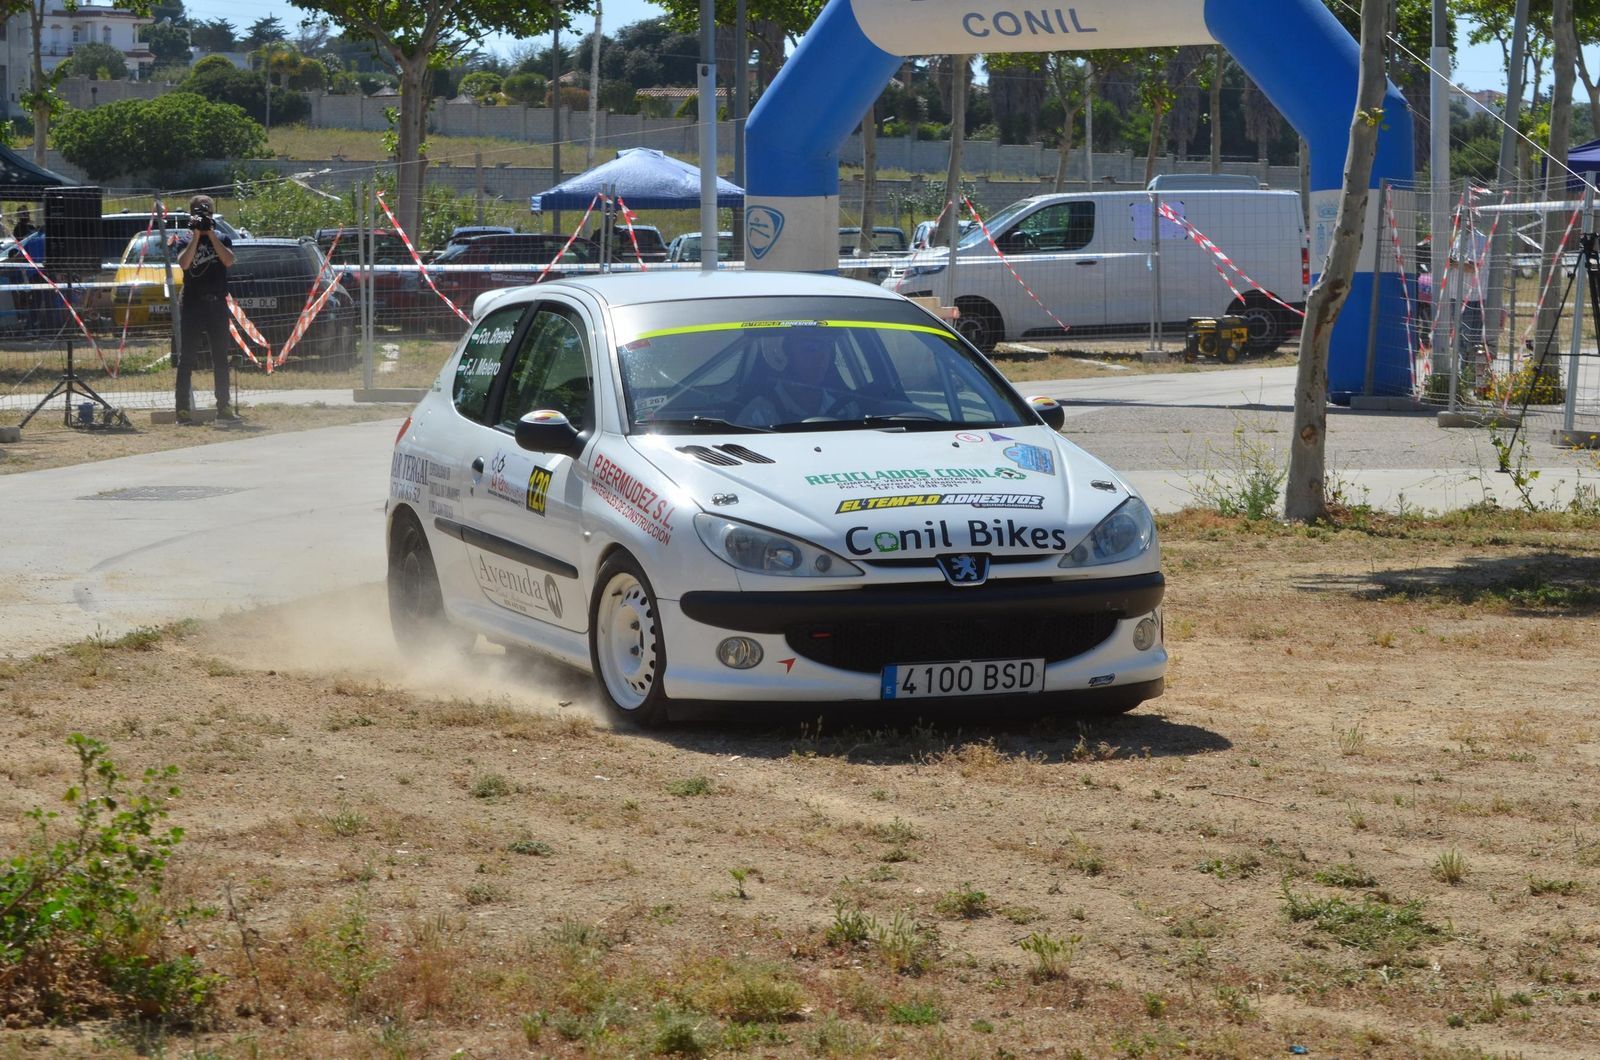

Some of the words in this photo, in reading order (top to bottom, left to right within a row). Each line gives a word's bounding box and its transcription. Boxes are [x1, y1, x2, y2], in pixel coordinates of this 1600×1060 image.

[962, 8, 1098, 38] CONIL
[530, 469, 551, 513] 120
[804, 468, 930, 486] RECICLADOS
[933, 467, 997, 478] CONIL
[840, 500, 862, 512] EL
[867, 495, 942, 509] TEMPLO
[941, 494, 1042, 505] ADHESIVOS
[845, 520, 952, 556] Conil
[968, 518, 1066, 551] Bikes
[480, 554, 545, 601] Avenida
[885, 686, 892, 694] E
[902, 664, 973, 695] 4100
[983, 661, 1035, 691] BSD
